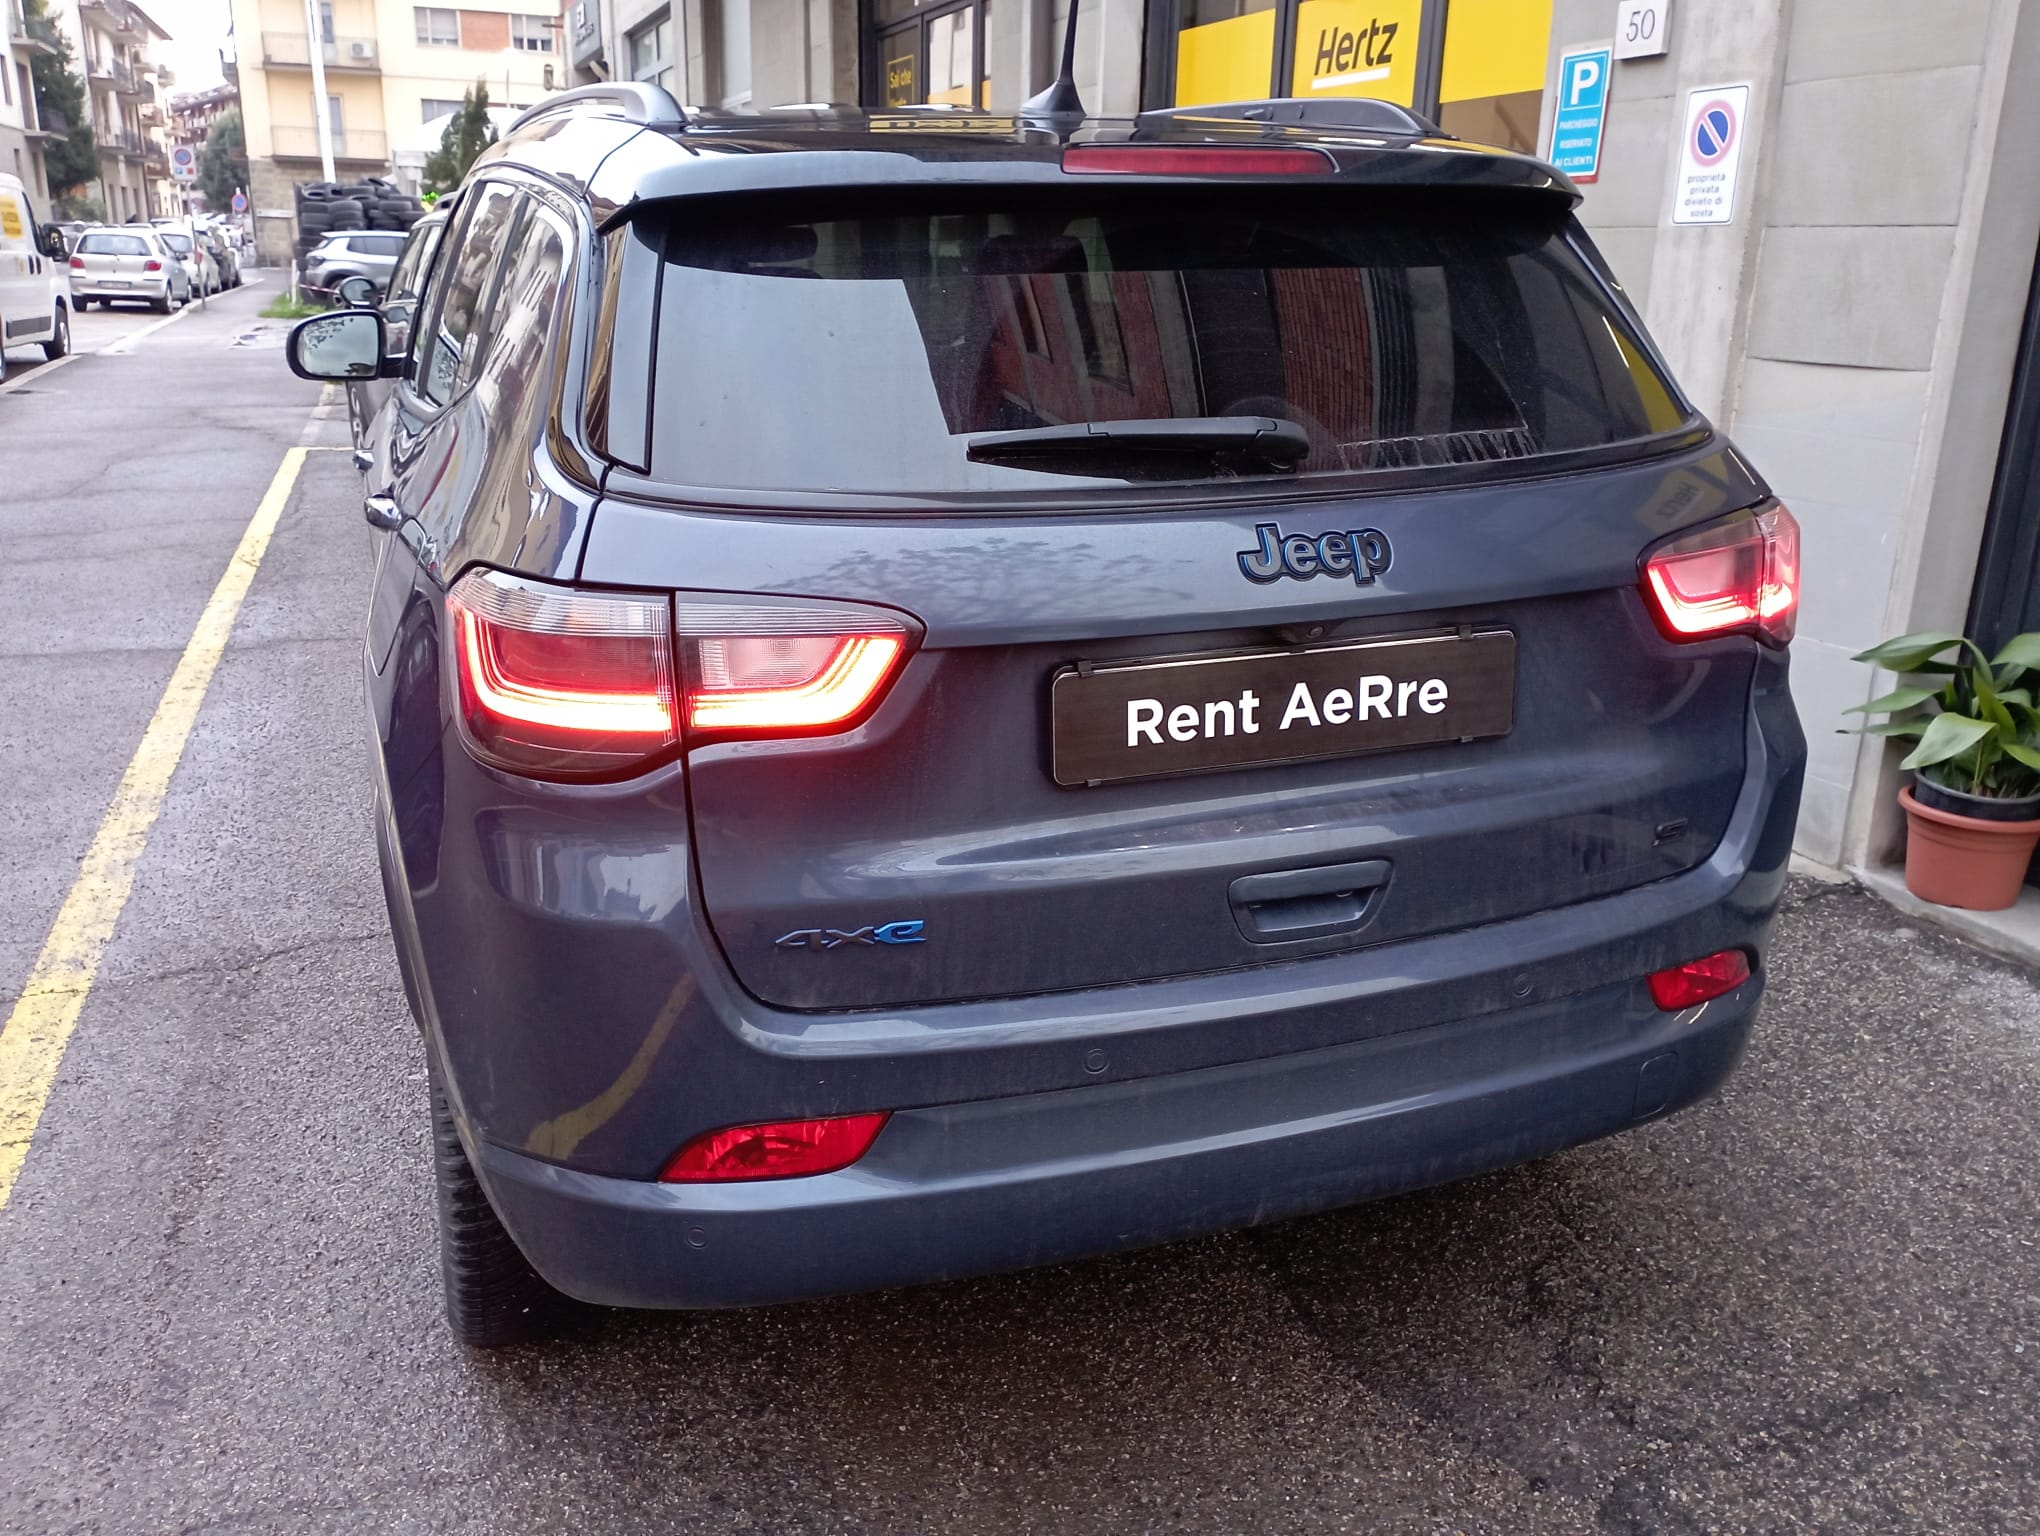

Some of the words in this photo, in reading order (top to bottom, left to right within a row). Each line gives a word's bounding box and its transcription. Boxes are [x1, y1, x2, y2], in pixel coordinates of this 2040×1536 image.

[1626, 9, 1655, 42] 50
[1314, 17, 1399, 76] Hertz
[1570, 61, 1599, 105] P
[1563, 155, 1593, 167] CLIENTI
[1684, 197, 1713, 206] divieto
[1714, 196, 1723, 205] di
[1690, 185, 1720, 195] privata
[1690, 209, 1713, 217] sosta
[1237, 524, 1393, 586] Jeep
[1126, 689, 1260, 748] Rent
[1279, 674, 1449, 731] AeRre
